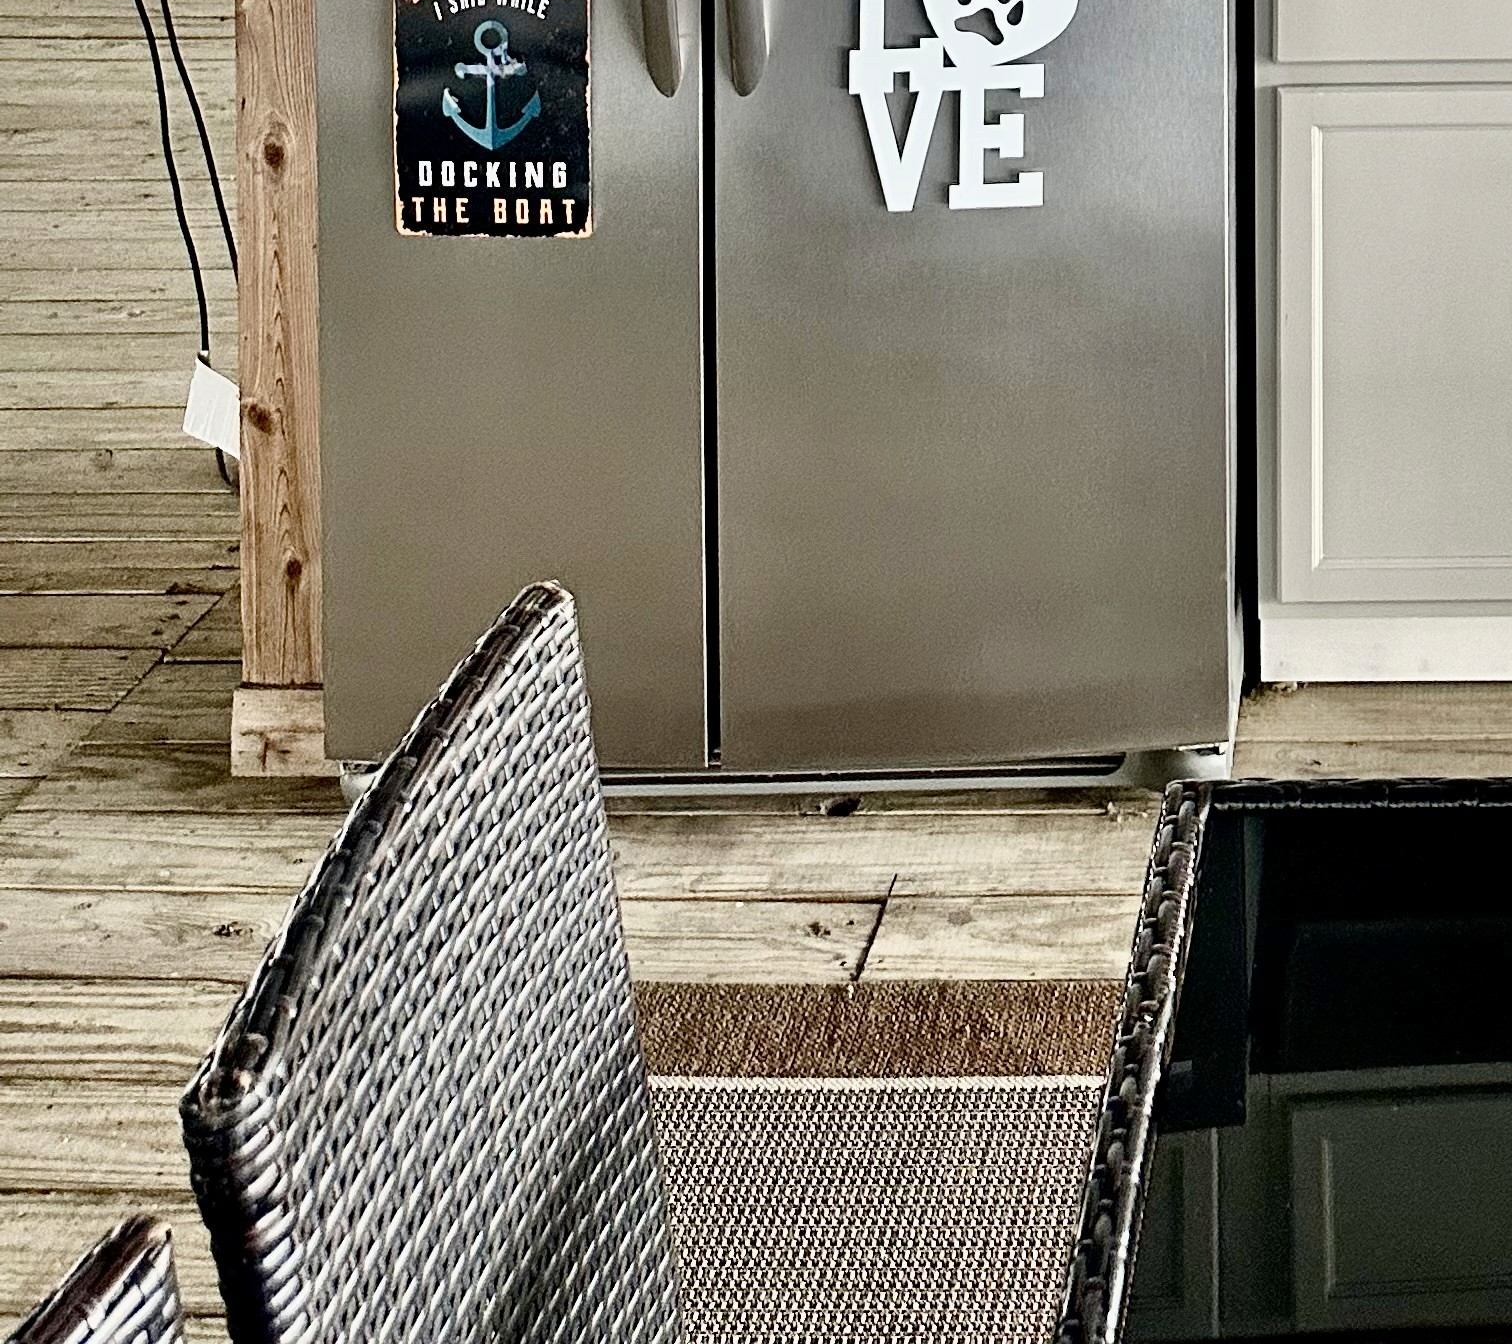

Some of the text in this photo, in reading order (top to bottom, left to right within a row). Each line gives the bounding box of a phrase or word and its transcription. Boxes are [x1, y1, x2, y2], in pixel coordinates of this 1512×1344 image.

[433, 0, 443, 20] I
[418, 160, 568, 188] DOCKING
[412, 197, 576, 224] THE BOAT
